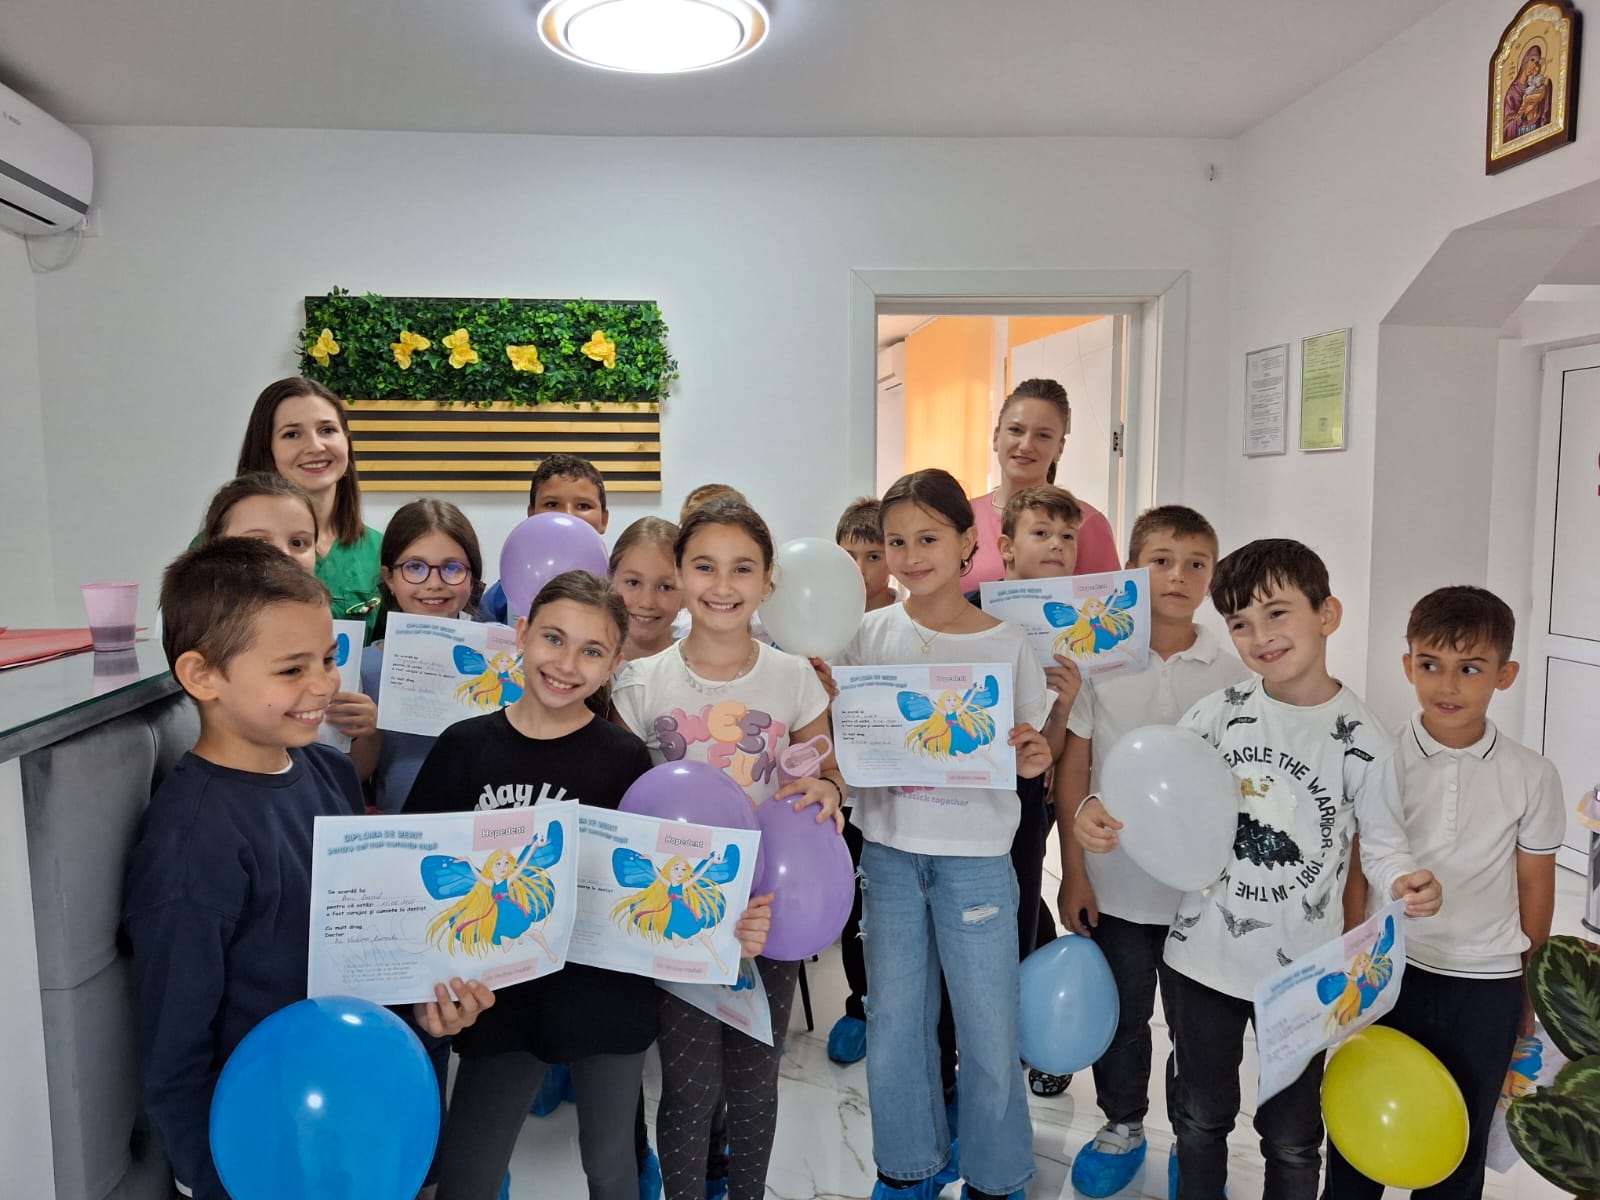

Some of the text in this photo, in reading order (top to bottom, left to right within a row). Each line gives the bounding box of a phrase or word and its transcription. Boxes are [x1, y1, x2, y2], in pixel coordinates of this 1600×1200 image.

[707, 743, 777, 787] FUN
[1223, 746, 1273, 769] EAGLE
[1278, 752, 1310, 781] THE
[931, 795, 969, 807] together
[1307, 776, 1337, 850] WARRIOR
[1296, 860, 1324, 889] 1981
[1235, 881, 1269, 902] THE
[1271, 884, 1289, 903] IN
